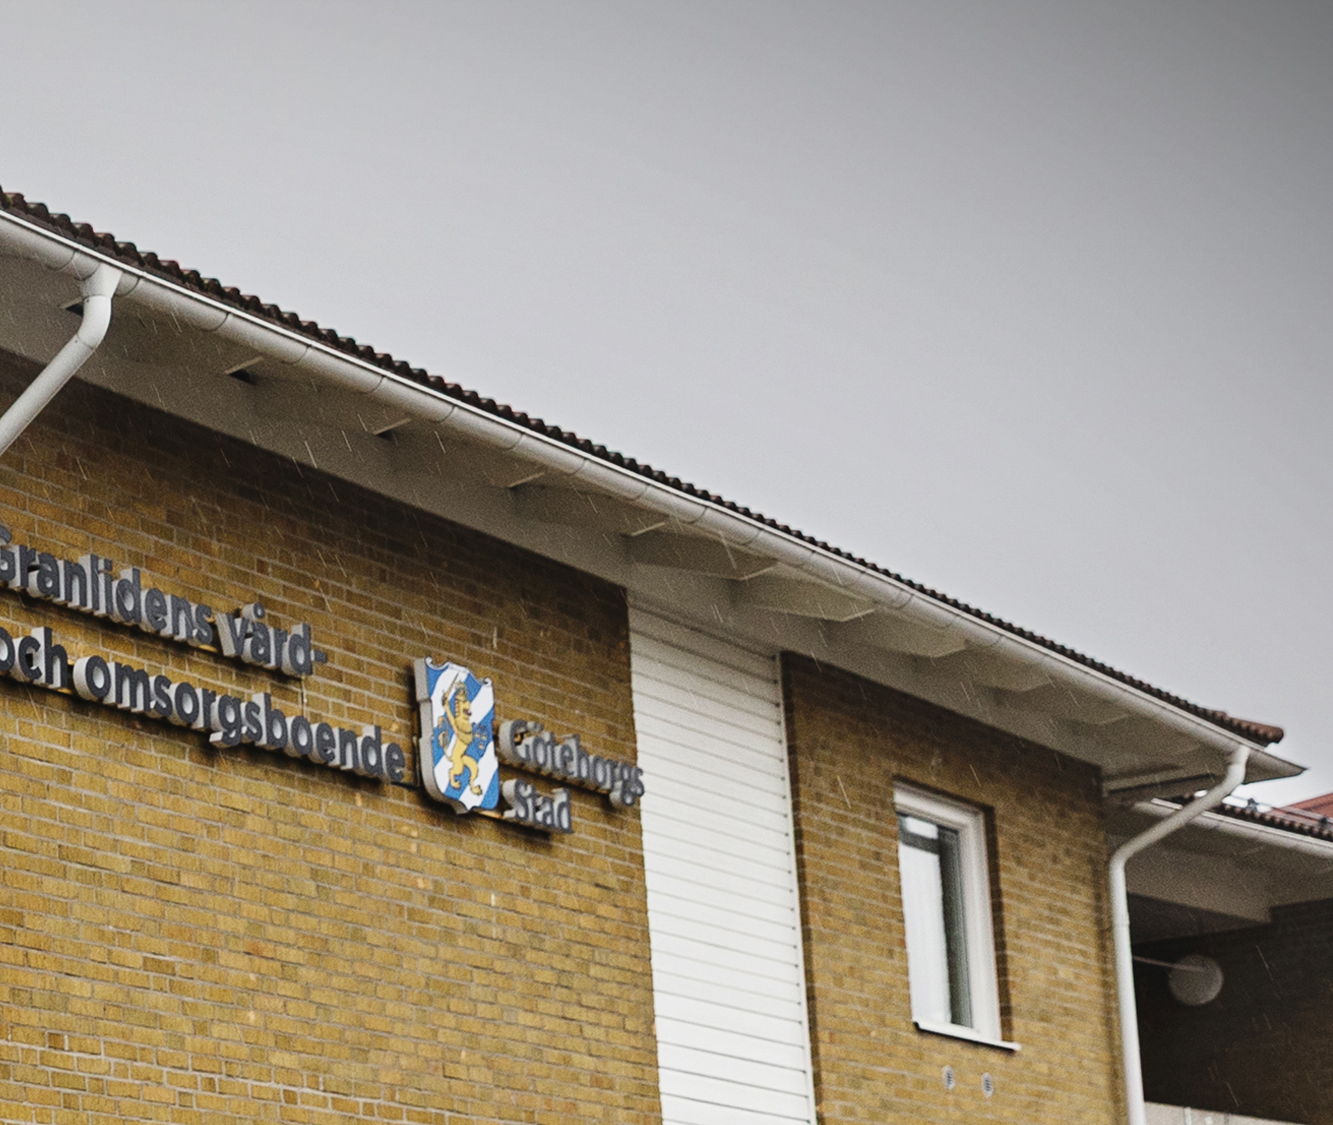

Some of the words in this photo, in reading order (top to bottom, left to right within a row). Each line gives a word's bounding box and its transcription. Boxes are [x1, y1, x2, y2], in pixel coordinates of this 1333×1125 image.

[216, 602, 327, 676] vård-
[73, 655, 405, 782] omsorgsboende
[499, 719, 645, 807] Göteborgs
[502, 778, 574, 834] Stad
